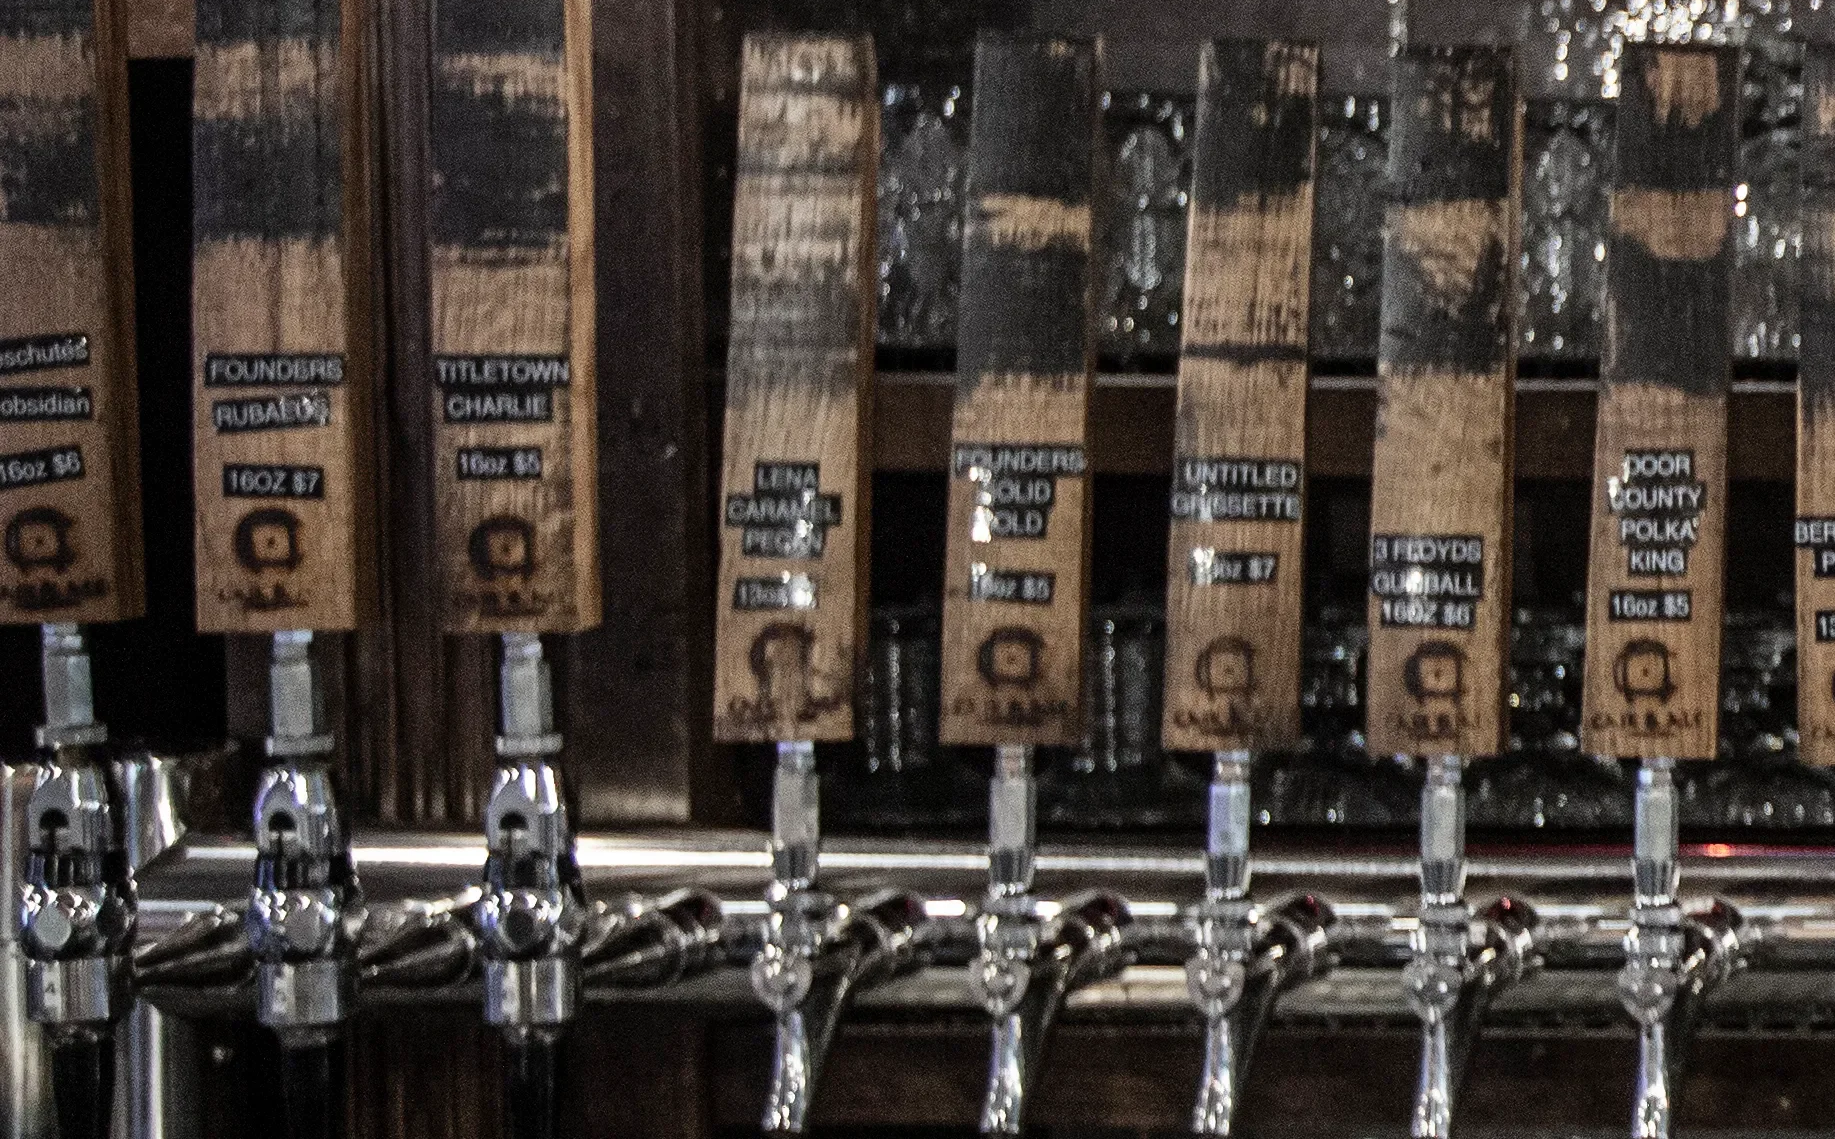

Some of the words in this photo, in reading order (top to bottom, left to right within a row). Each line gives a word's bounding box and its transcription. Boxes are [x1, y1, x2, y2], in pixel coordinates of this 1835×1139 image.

[209, 360, 343, 382] FOUNDERS
[437, 359, 571, 384] TITLETOWN
[0, 392, 90, 418] obsidian
[447, 393, 547, 419] CHARLIE
[955, 448, 1086, 472] FOUNDERS
[1626, 455, 1691, 478] DOOR
[756, 466, 819, 491] LENA
[1183, 464, 1297, 487] UNTITLED
[979, 478, 1051, 503] OLID
[1611, 486, 1702, 512] COUNTY
[976, 510, 1044, 535] OLD
[1621, 518, 1698, 543] POLKA
[1631, 549, 1688, 574] KING
[1373, 571, 1479, 596] GUBALL
